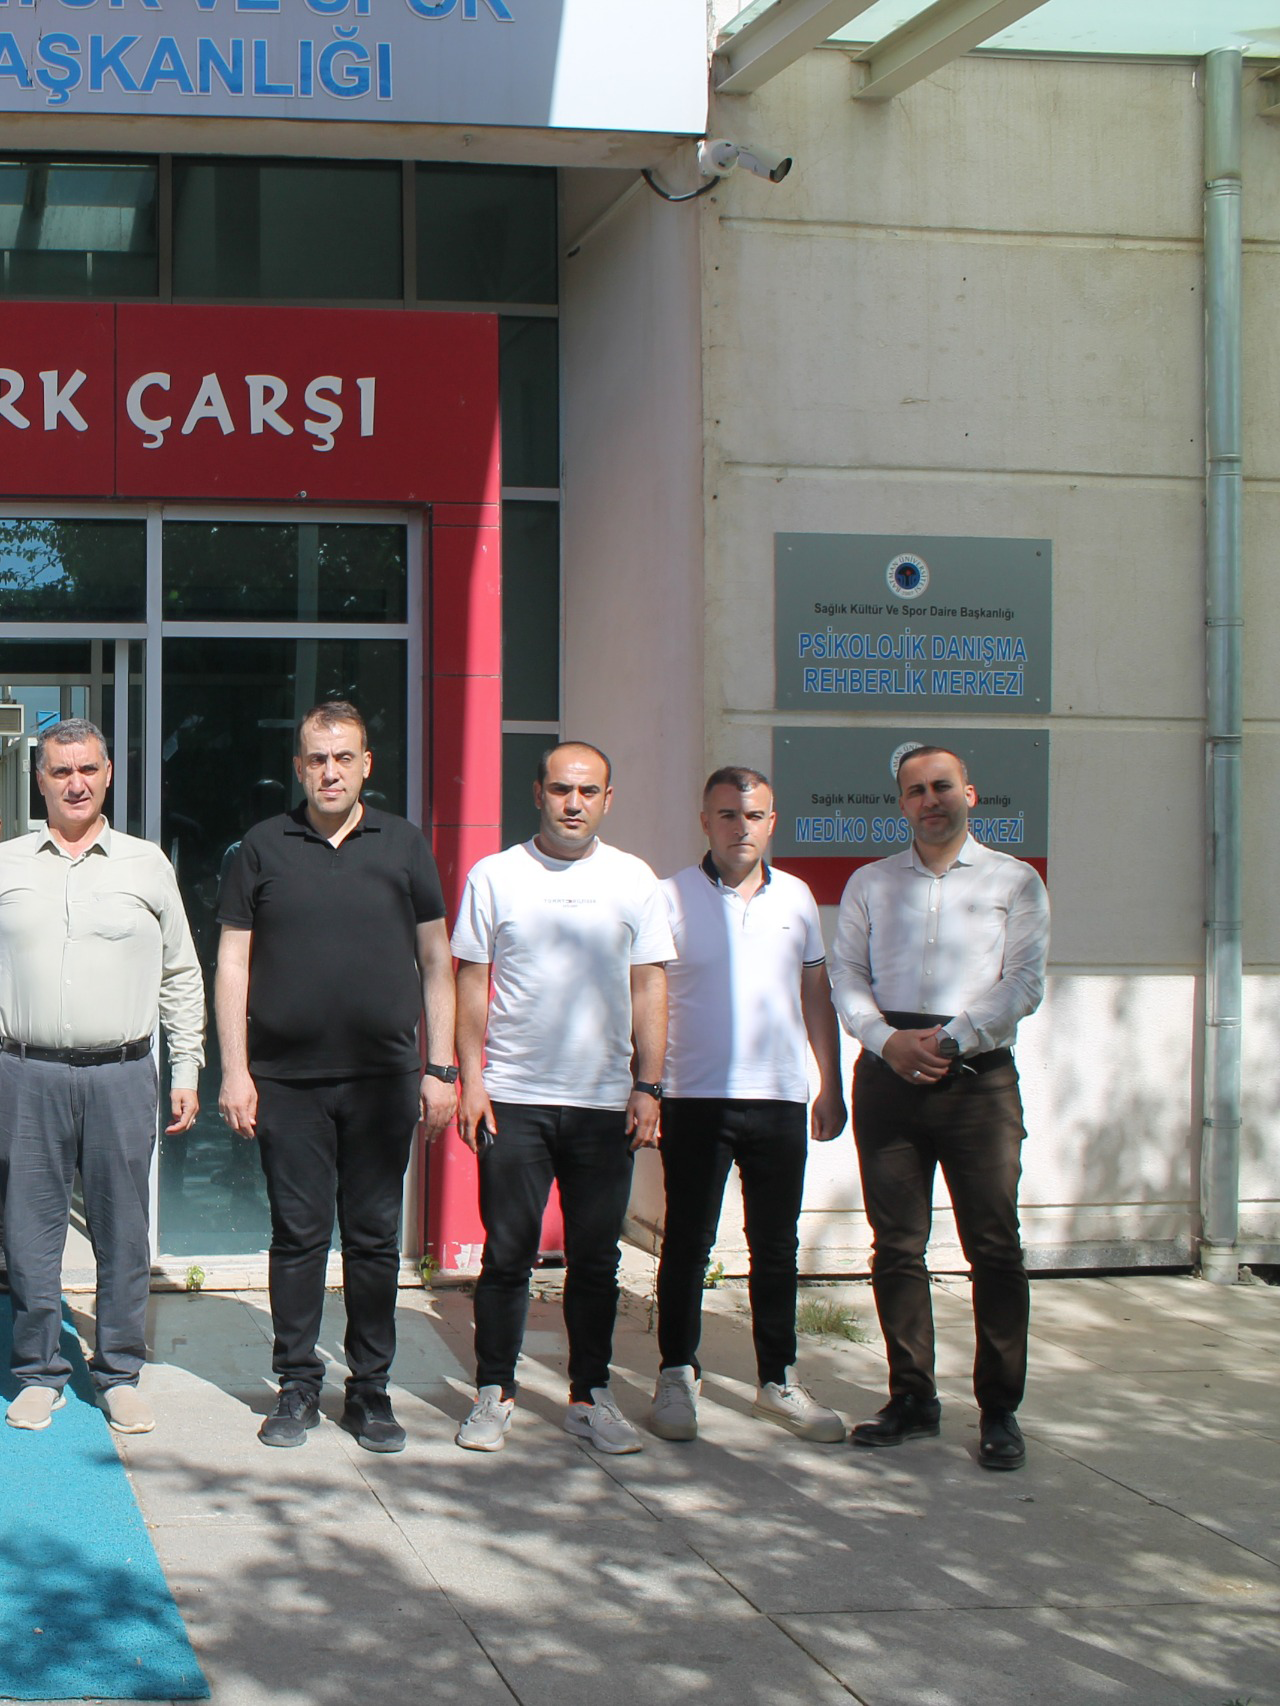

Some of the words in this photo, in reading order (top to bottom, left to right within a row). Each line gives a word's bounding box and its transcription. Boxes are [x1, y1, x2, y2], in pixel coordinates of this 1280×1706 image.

[126, 371, 376, 452] ÇARŞI
[814, 603, 847, 616] Sağlık
[850, 604, 883, 615] Kültür
[886, 605, 899, 615] Ve
[902, 605, 927, 617] Spor
[930, 606, 957, 617] Daire
[960, 607, 1015, 621] Başkanlığı
[798, 626, 927, 661] PSİKOLOJİK
[932, 635, 1028, 667] DANIŞMA
[803, 662, 926, 694] REHBERLİK
[932, 664, 1024, 696] MERKEZİ
[811, 793, 844, 807] Sağlık
[847, 793, 880, 805] Kültür
[883, 793, 896, 805] Ve
[977, 795, 1011, 807] kanlığı
[795, 809, 867, 843] MEDİKO
[871, 816, 910, 843] SOS
[967, 810, 1024, 843] RKEZİ
